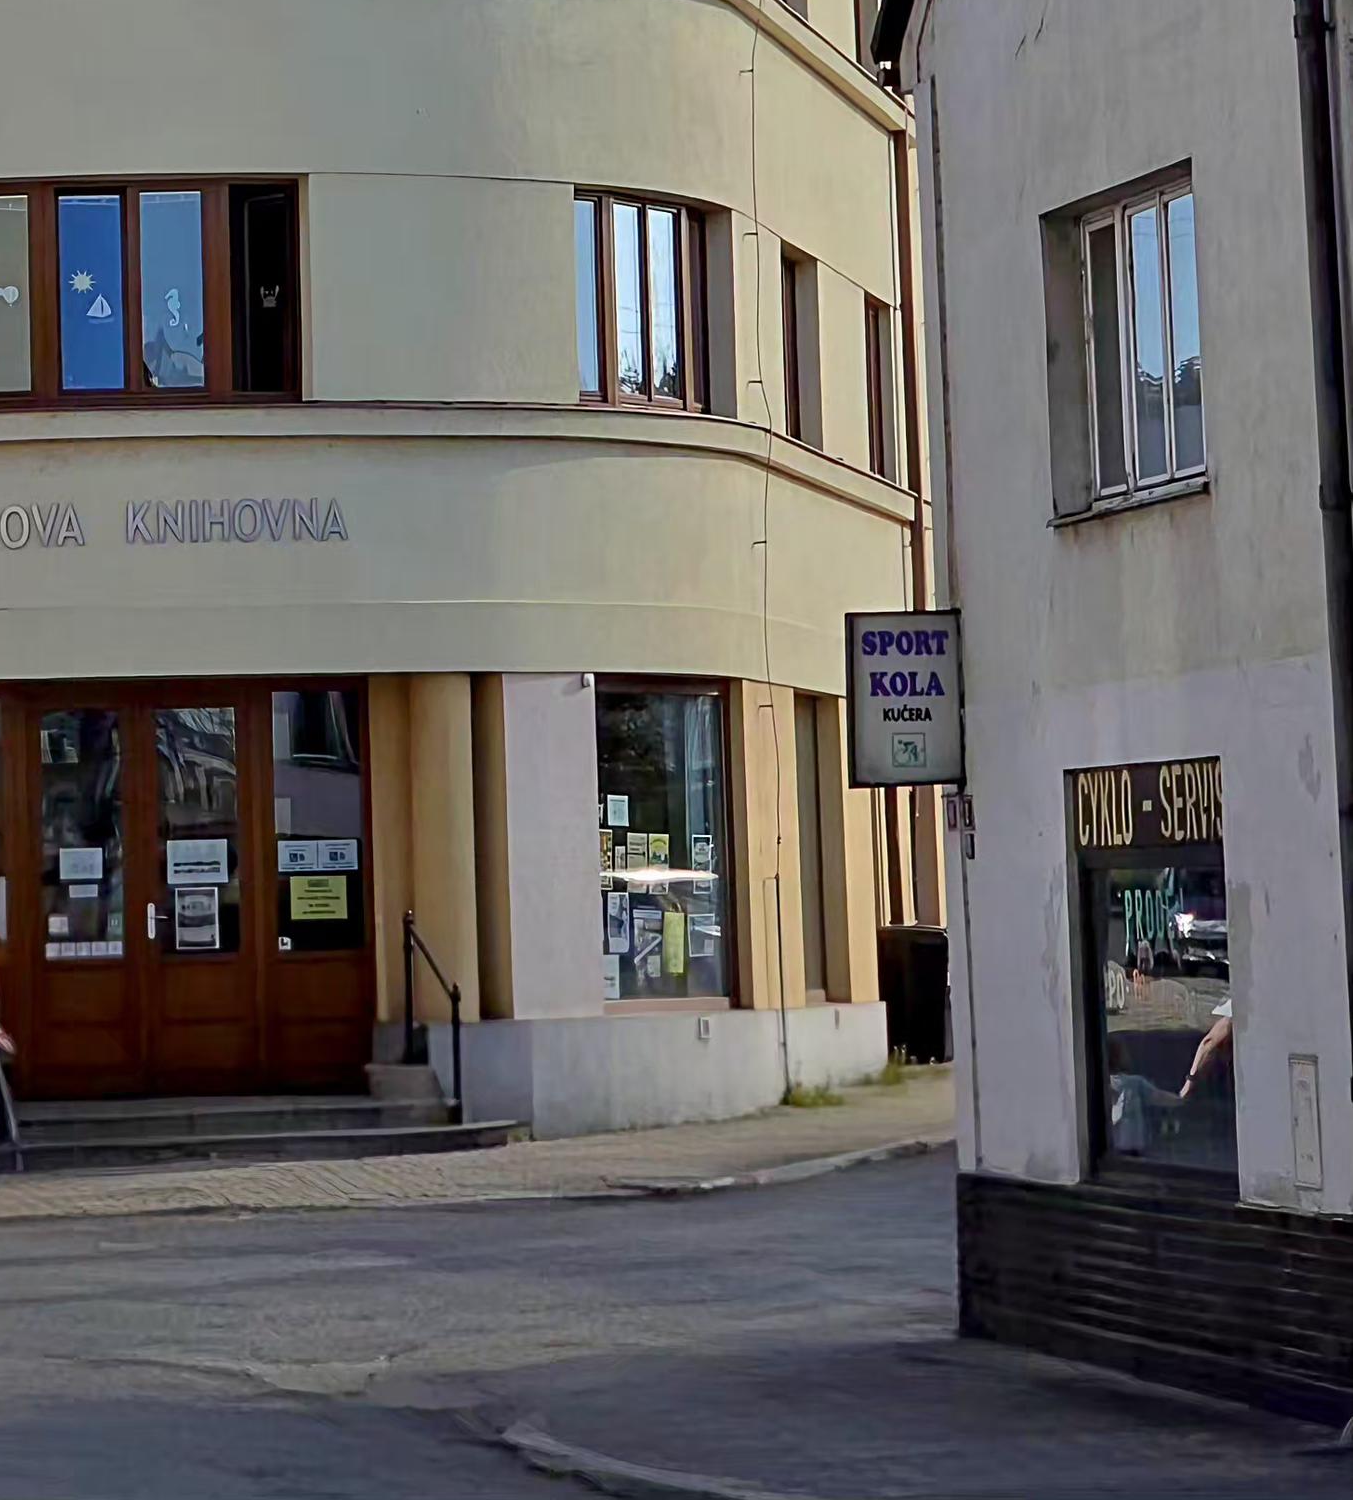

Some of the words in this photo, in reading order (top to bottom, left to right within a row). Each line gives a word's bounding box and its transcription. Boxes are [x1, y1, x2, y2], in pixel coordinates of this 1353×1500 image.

[124, 497, 349, 545] KNIHOVNA
[861, 630, 949, 656] SPORT
[869, 671, 945, 697] KOLA
[882, 704, 932, 722] KUČERA
[1078, 770, 1133, 846] CYKLO
